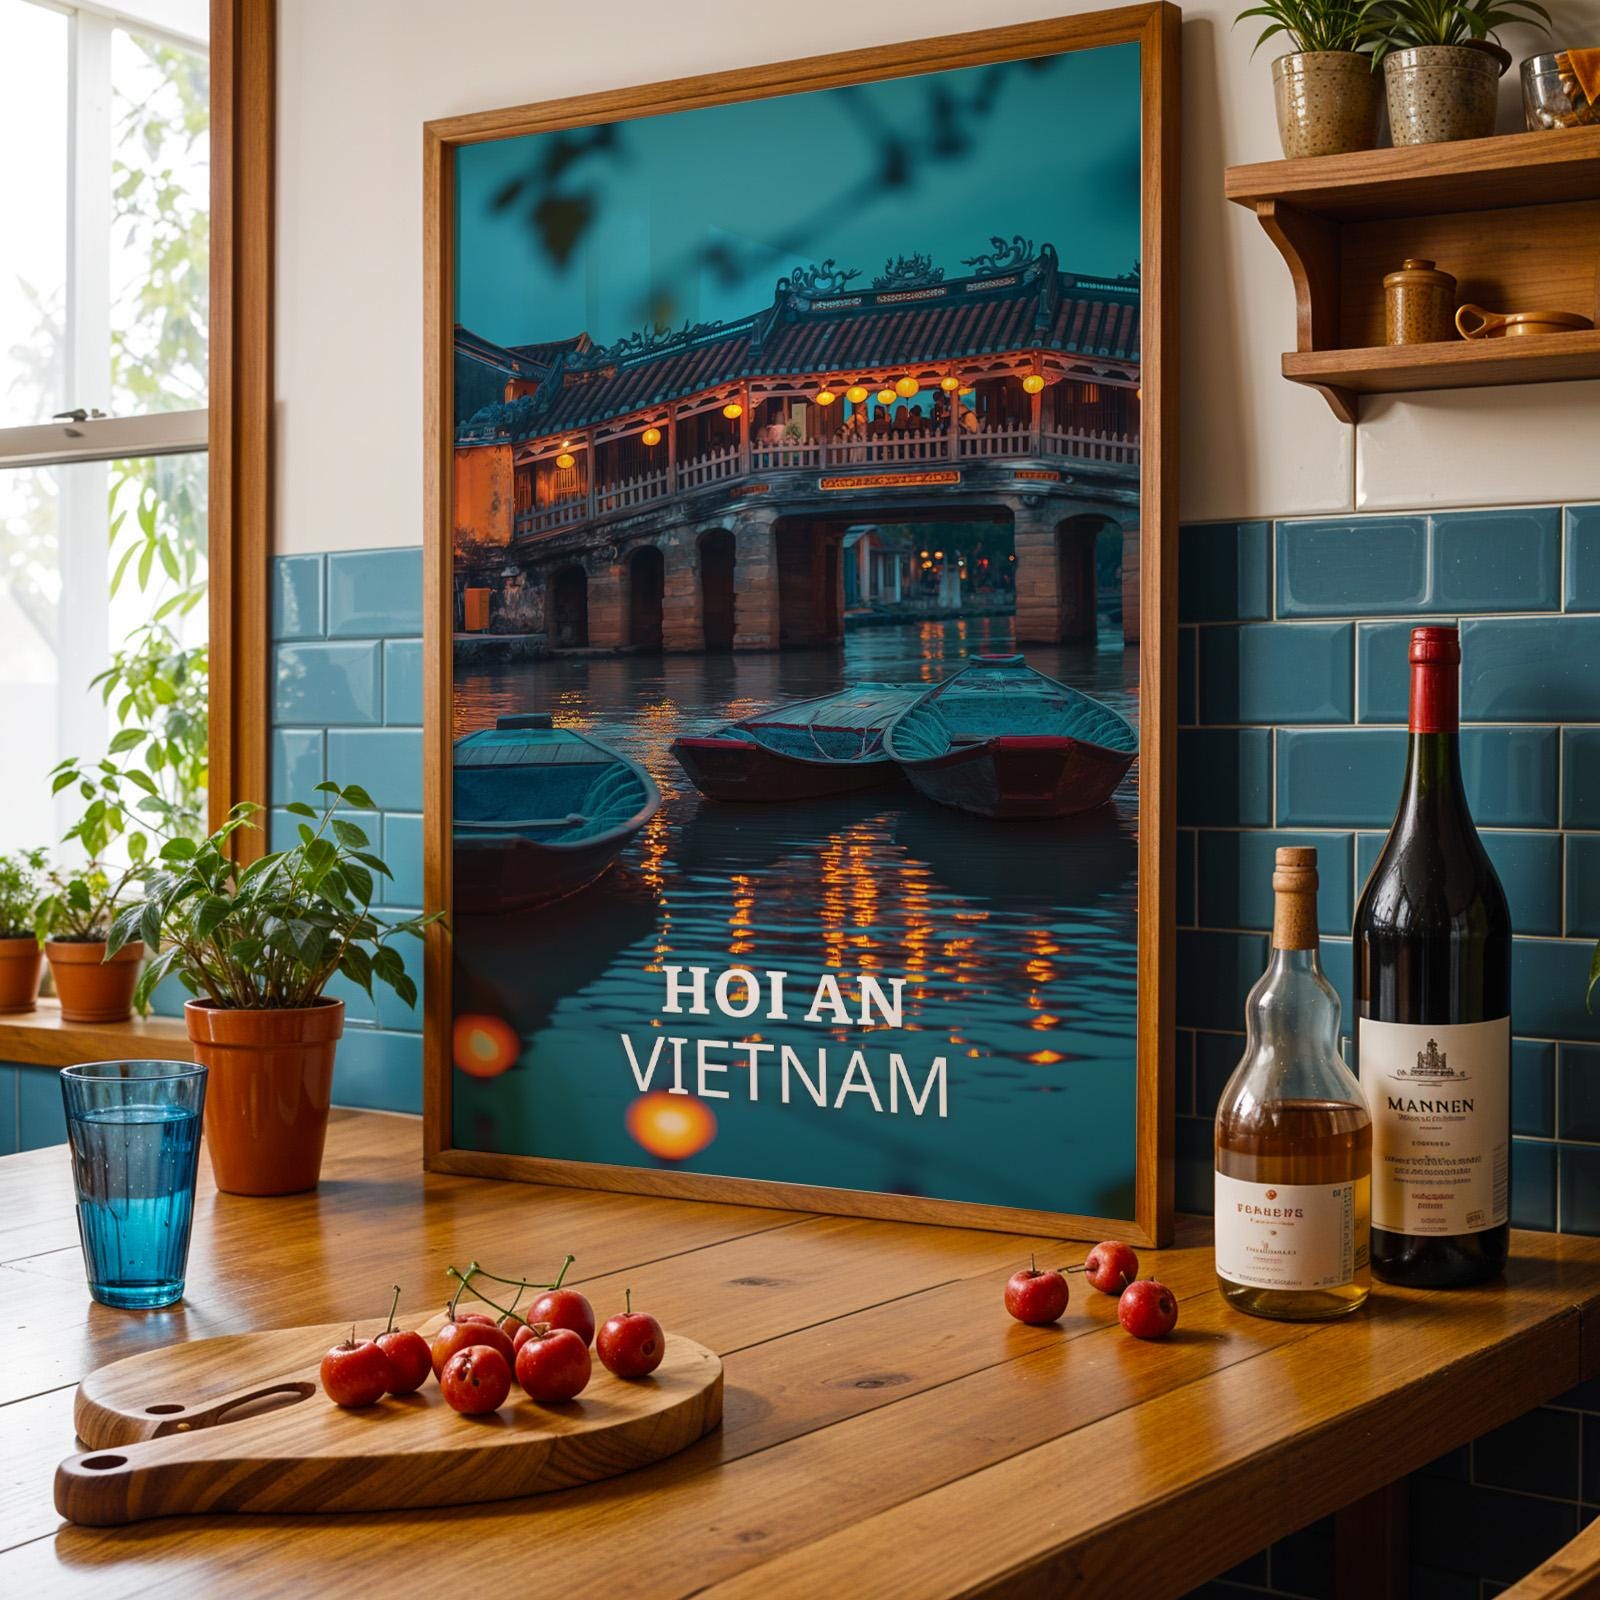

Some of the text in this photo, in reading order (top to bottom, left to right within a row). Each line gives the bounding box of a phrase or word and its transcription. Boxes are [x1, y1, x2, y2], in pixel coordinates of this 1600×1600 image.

[662, 965, 907, 1028] HOI AN
[620, 1033, 948, 1118] VIETNAM
[1387, 1096, 1474, 1113] MANNEN
